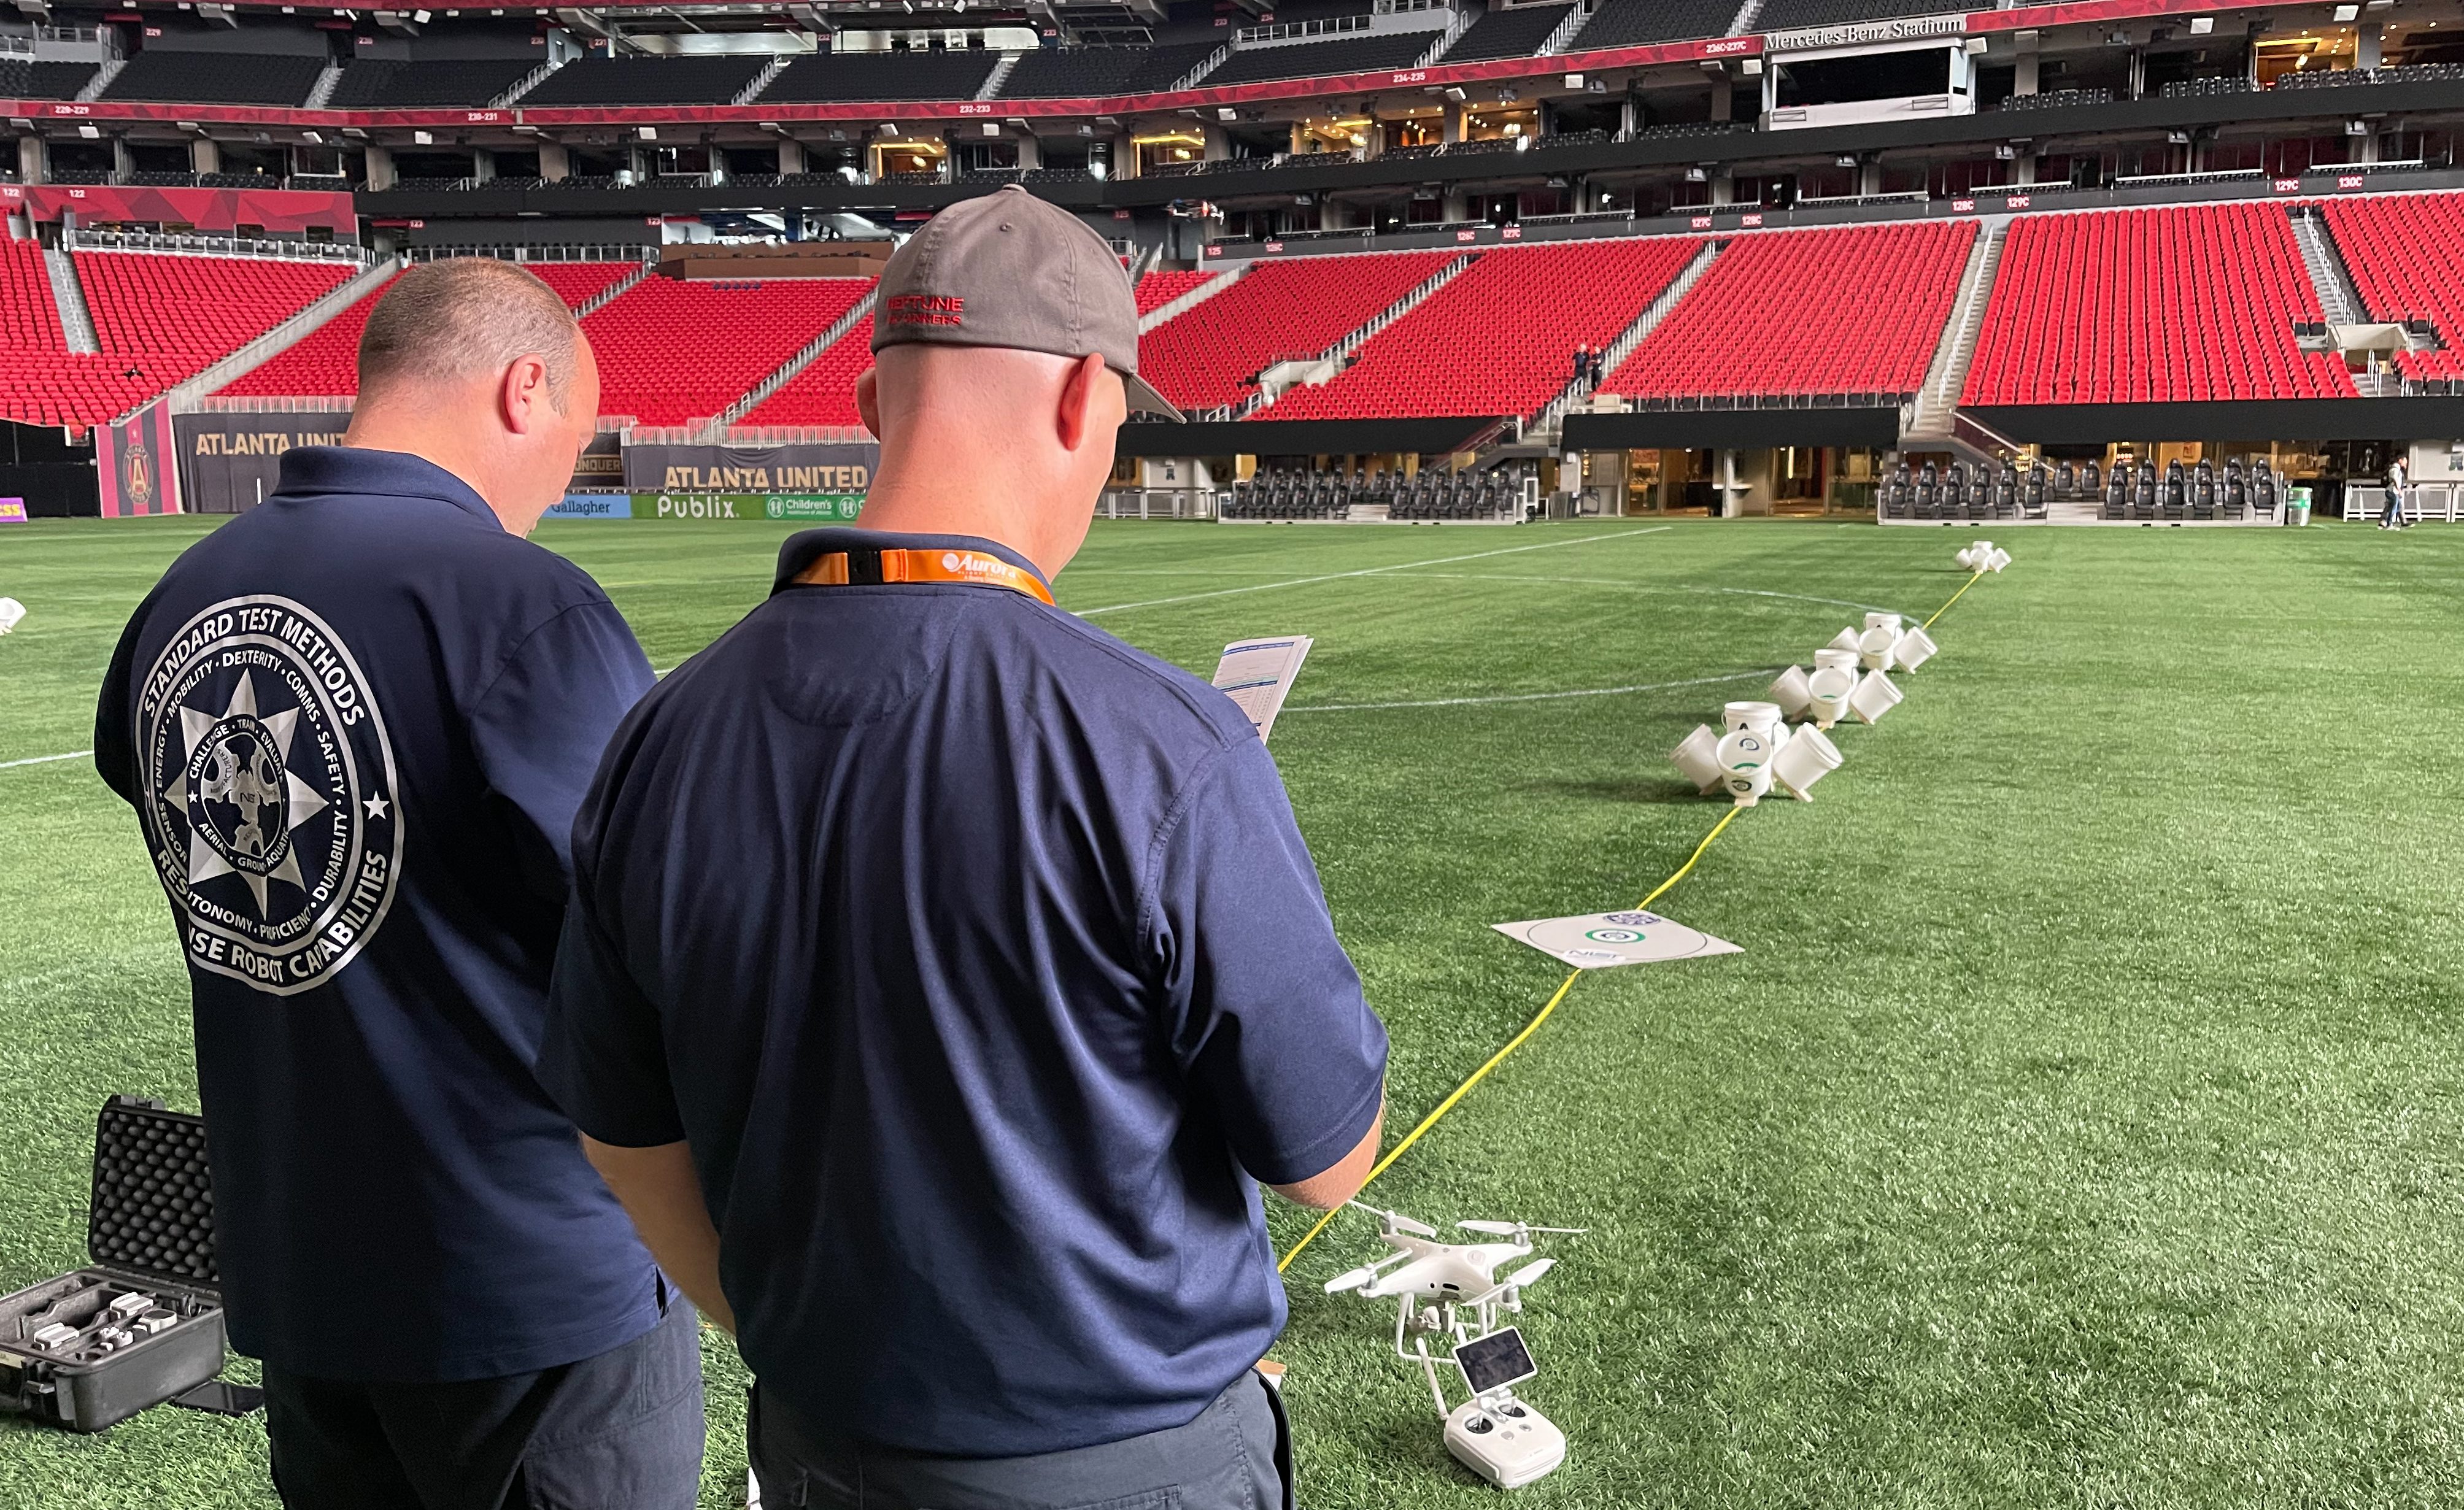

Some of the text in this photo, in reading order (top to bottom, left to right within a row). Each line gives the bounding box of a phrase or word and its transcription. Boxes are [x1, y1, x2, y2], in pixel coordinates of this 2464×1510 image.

[1764, 18, 1963, 50] Mercedes-Benz Stadium
[1393, 72, 1426, 83] 234-235
[2274, 179, 2299, 191] 129C
[2338, 175, 2363, 188] 130C
[2007, 196, 2030, 208] 129C
[196, 433, 292, 455] ATLANTA
[574, 459, 621, 472] ONQUER
[664, 466, 868, 488] ATLANTA UNITED
[551, 500, 611, 515] Gallagher
[657, 496, 735, 518] Publix
[786, 499, 832, 510] Children's
[957, 554, 1017, 579] Aurora
[144, 608, 365, 726] STANDARD TEST METHODS
[155, 724, 168, 788] ENERGY
[166, 659, 213, 718] MOBILITY
[222, 649, 282, 672] DEXTERITY
[285, 670, 321, 723] COMMS
[317, 731, 346, 795] SAFETY
[198, 823, 228, 857] AERIAL
[266, 826, 289, 867] AQUATIC
[188, 891, 253, 933] TONOMY
[312, 810, 347, 902] DURABILITY
[231, 945, 283, 983] ROBOT
